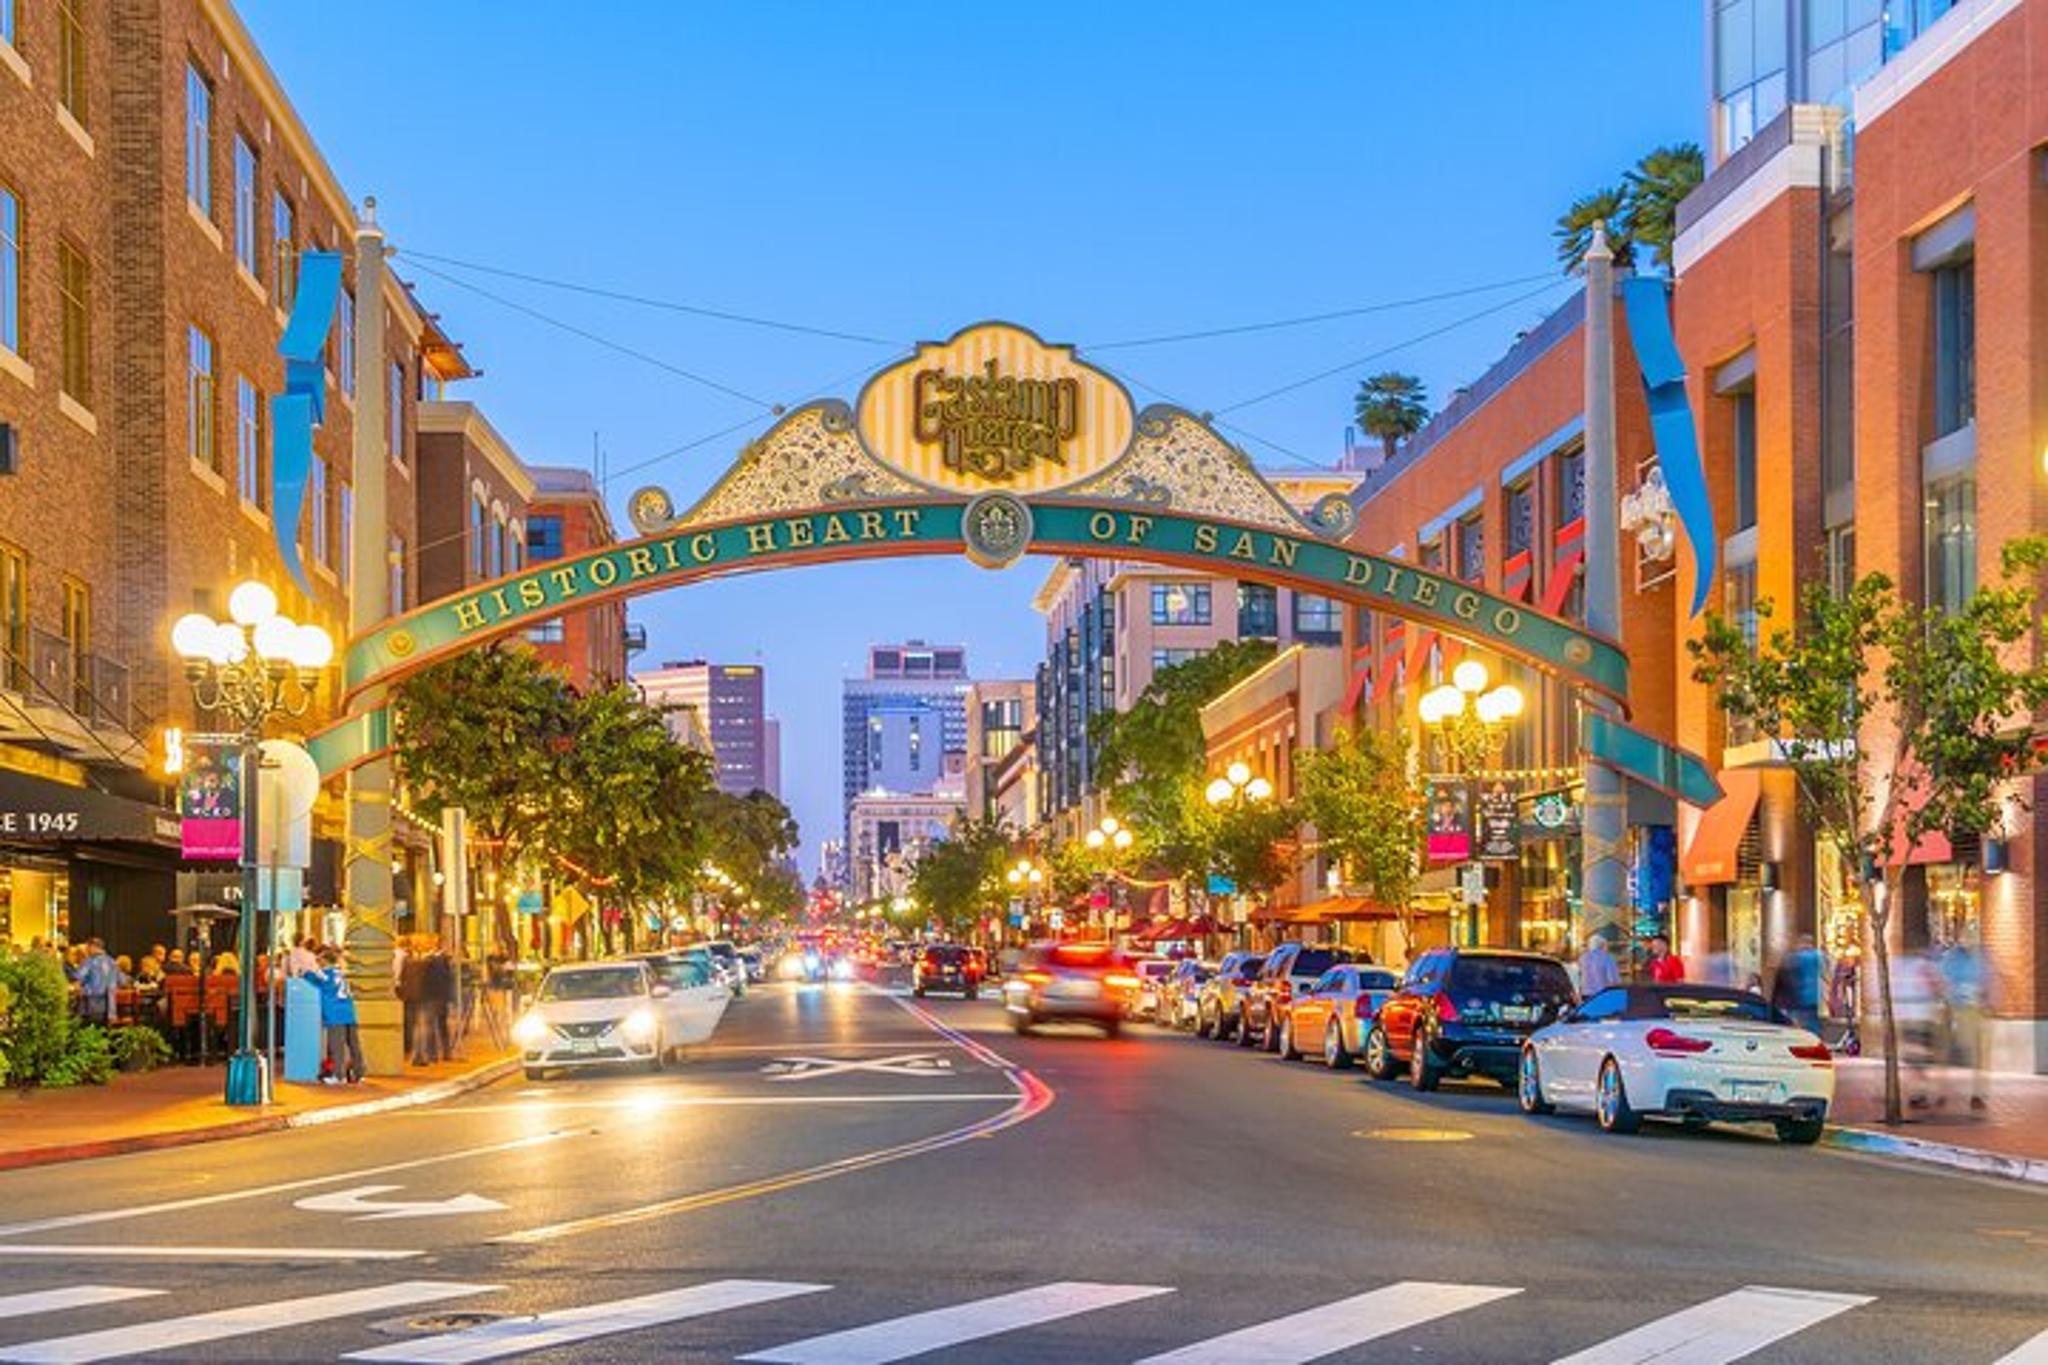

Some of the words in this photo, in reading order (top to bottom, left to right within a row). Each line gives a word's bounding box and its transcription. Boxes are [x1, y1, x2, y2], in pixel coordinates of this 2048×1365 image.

[453, 532, 718, 629] HISTORIC
[749, 509, 921, 552] HEART
[1089, 511, 1153, 543] OF
[1195, 526, 1301, 569] SAN
[1346, 557, 1522, 636] DIEGO
[27, 813, 79, 832] 1945
